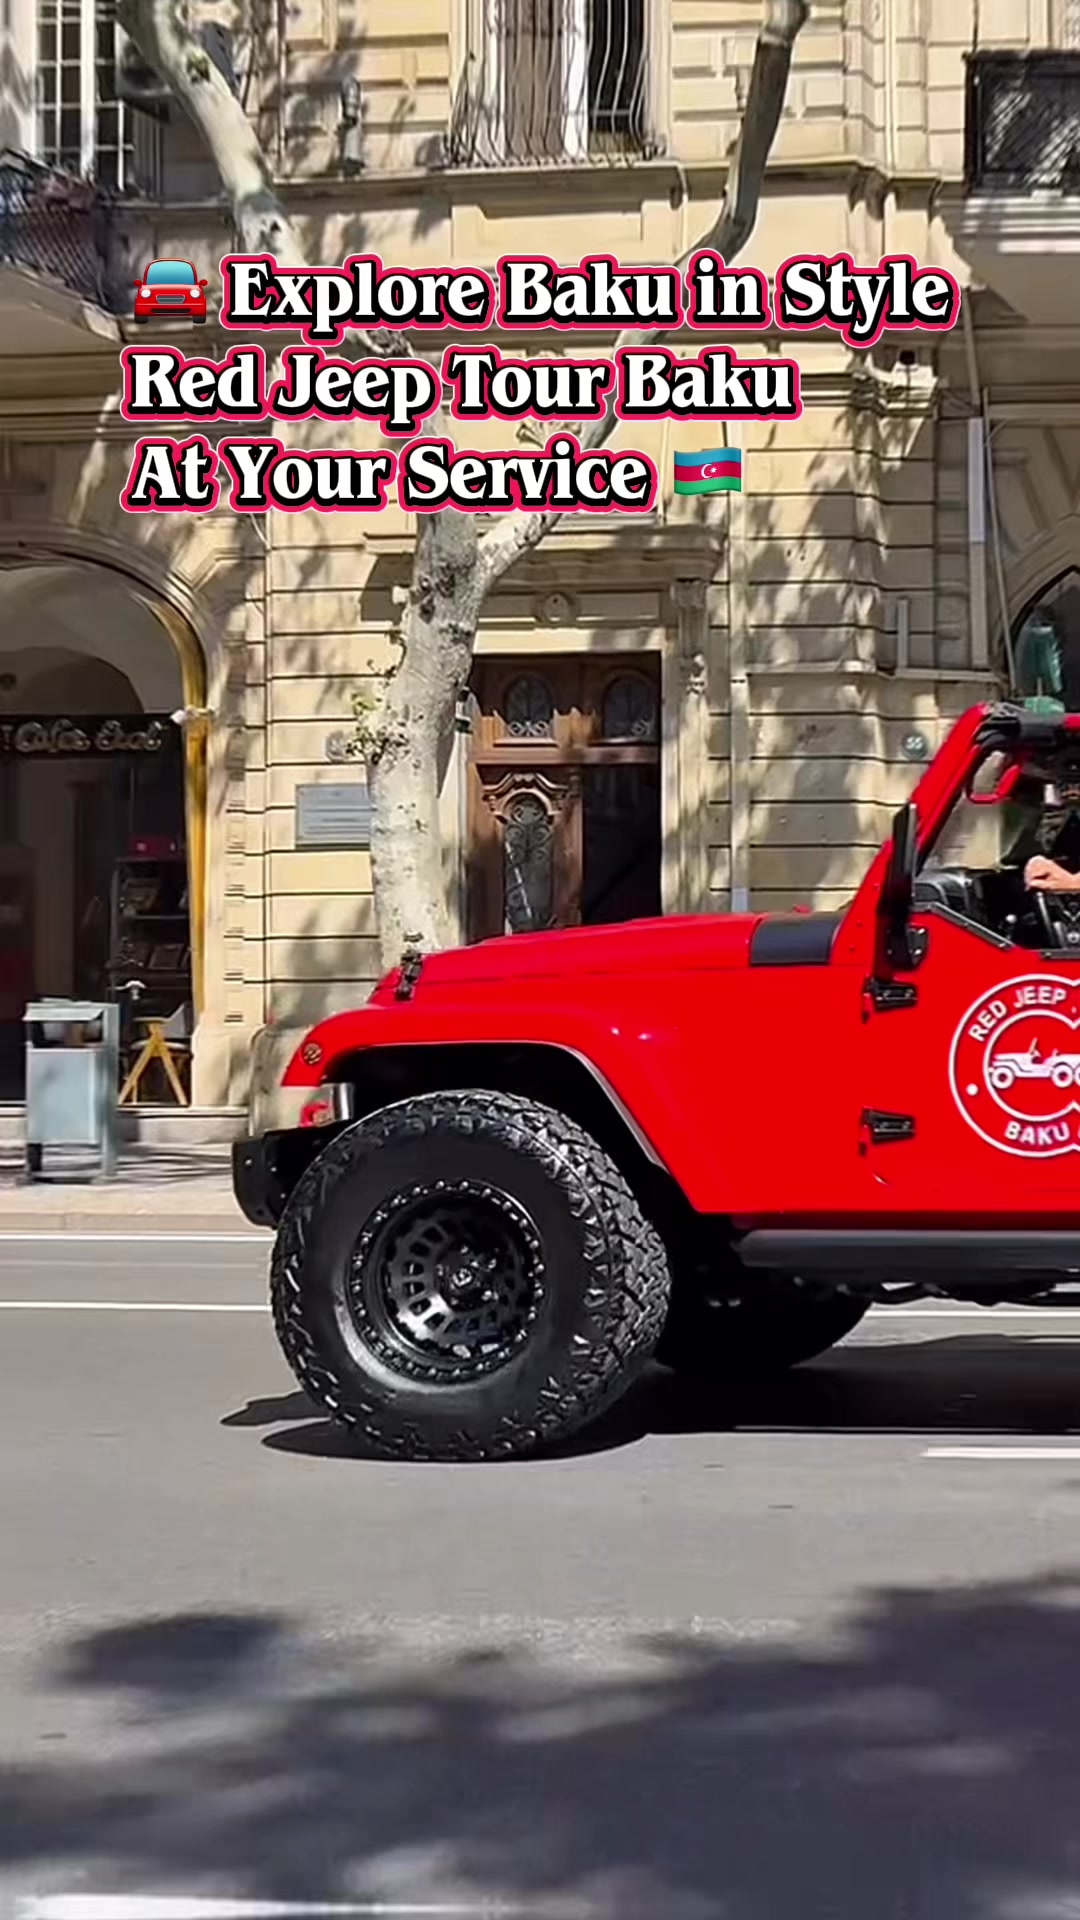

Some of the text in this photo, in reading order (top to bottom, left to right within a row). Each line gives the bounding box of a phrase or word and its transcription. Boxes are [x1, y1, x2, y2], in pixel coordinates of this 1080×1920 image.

[968, 985, 1067, 1042] RED JEEP
[1004, 1120, 1070, 1146] BAKU
